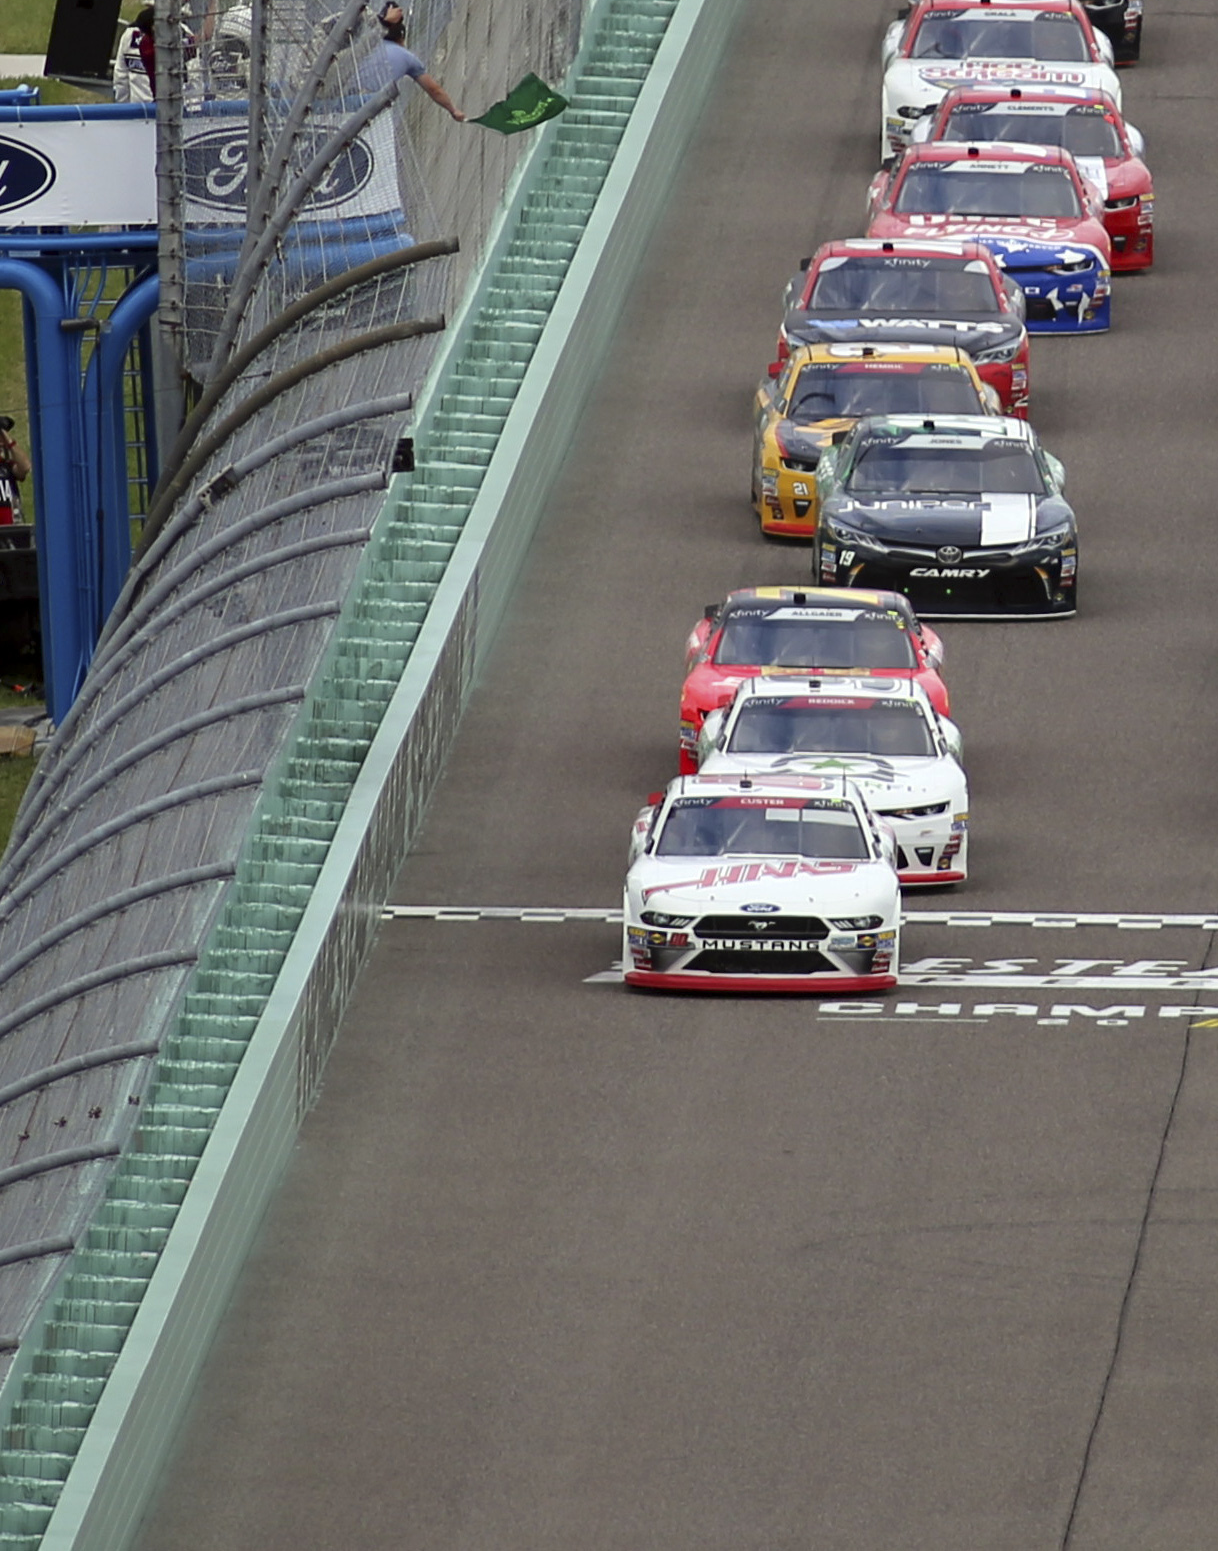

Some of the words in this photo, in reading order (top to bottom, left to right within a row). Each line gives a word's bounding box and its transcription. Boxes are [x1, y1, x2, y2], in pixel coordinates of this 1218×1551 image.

[793, 481, 809, 496] 21
[839, 550, 855, 566] 19
[909, 567, 990, 578] CAMRY
[702, 940, 820, 950] MUSTANG
